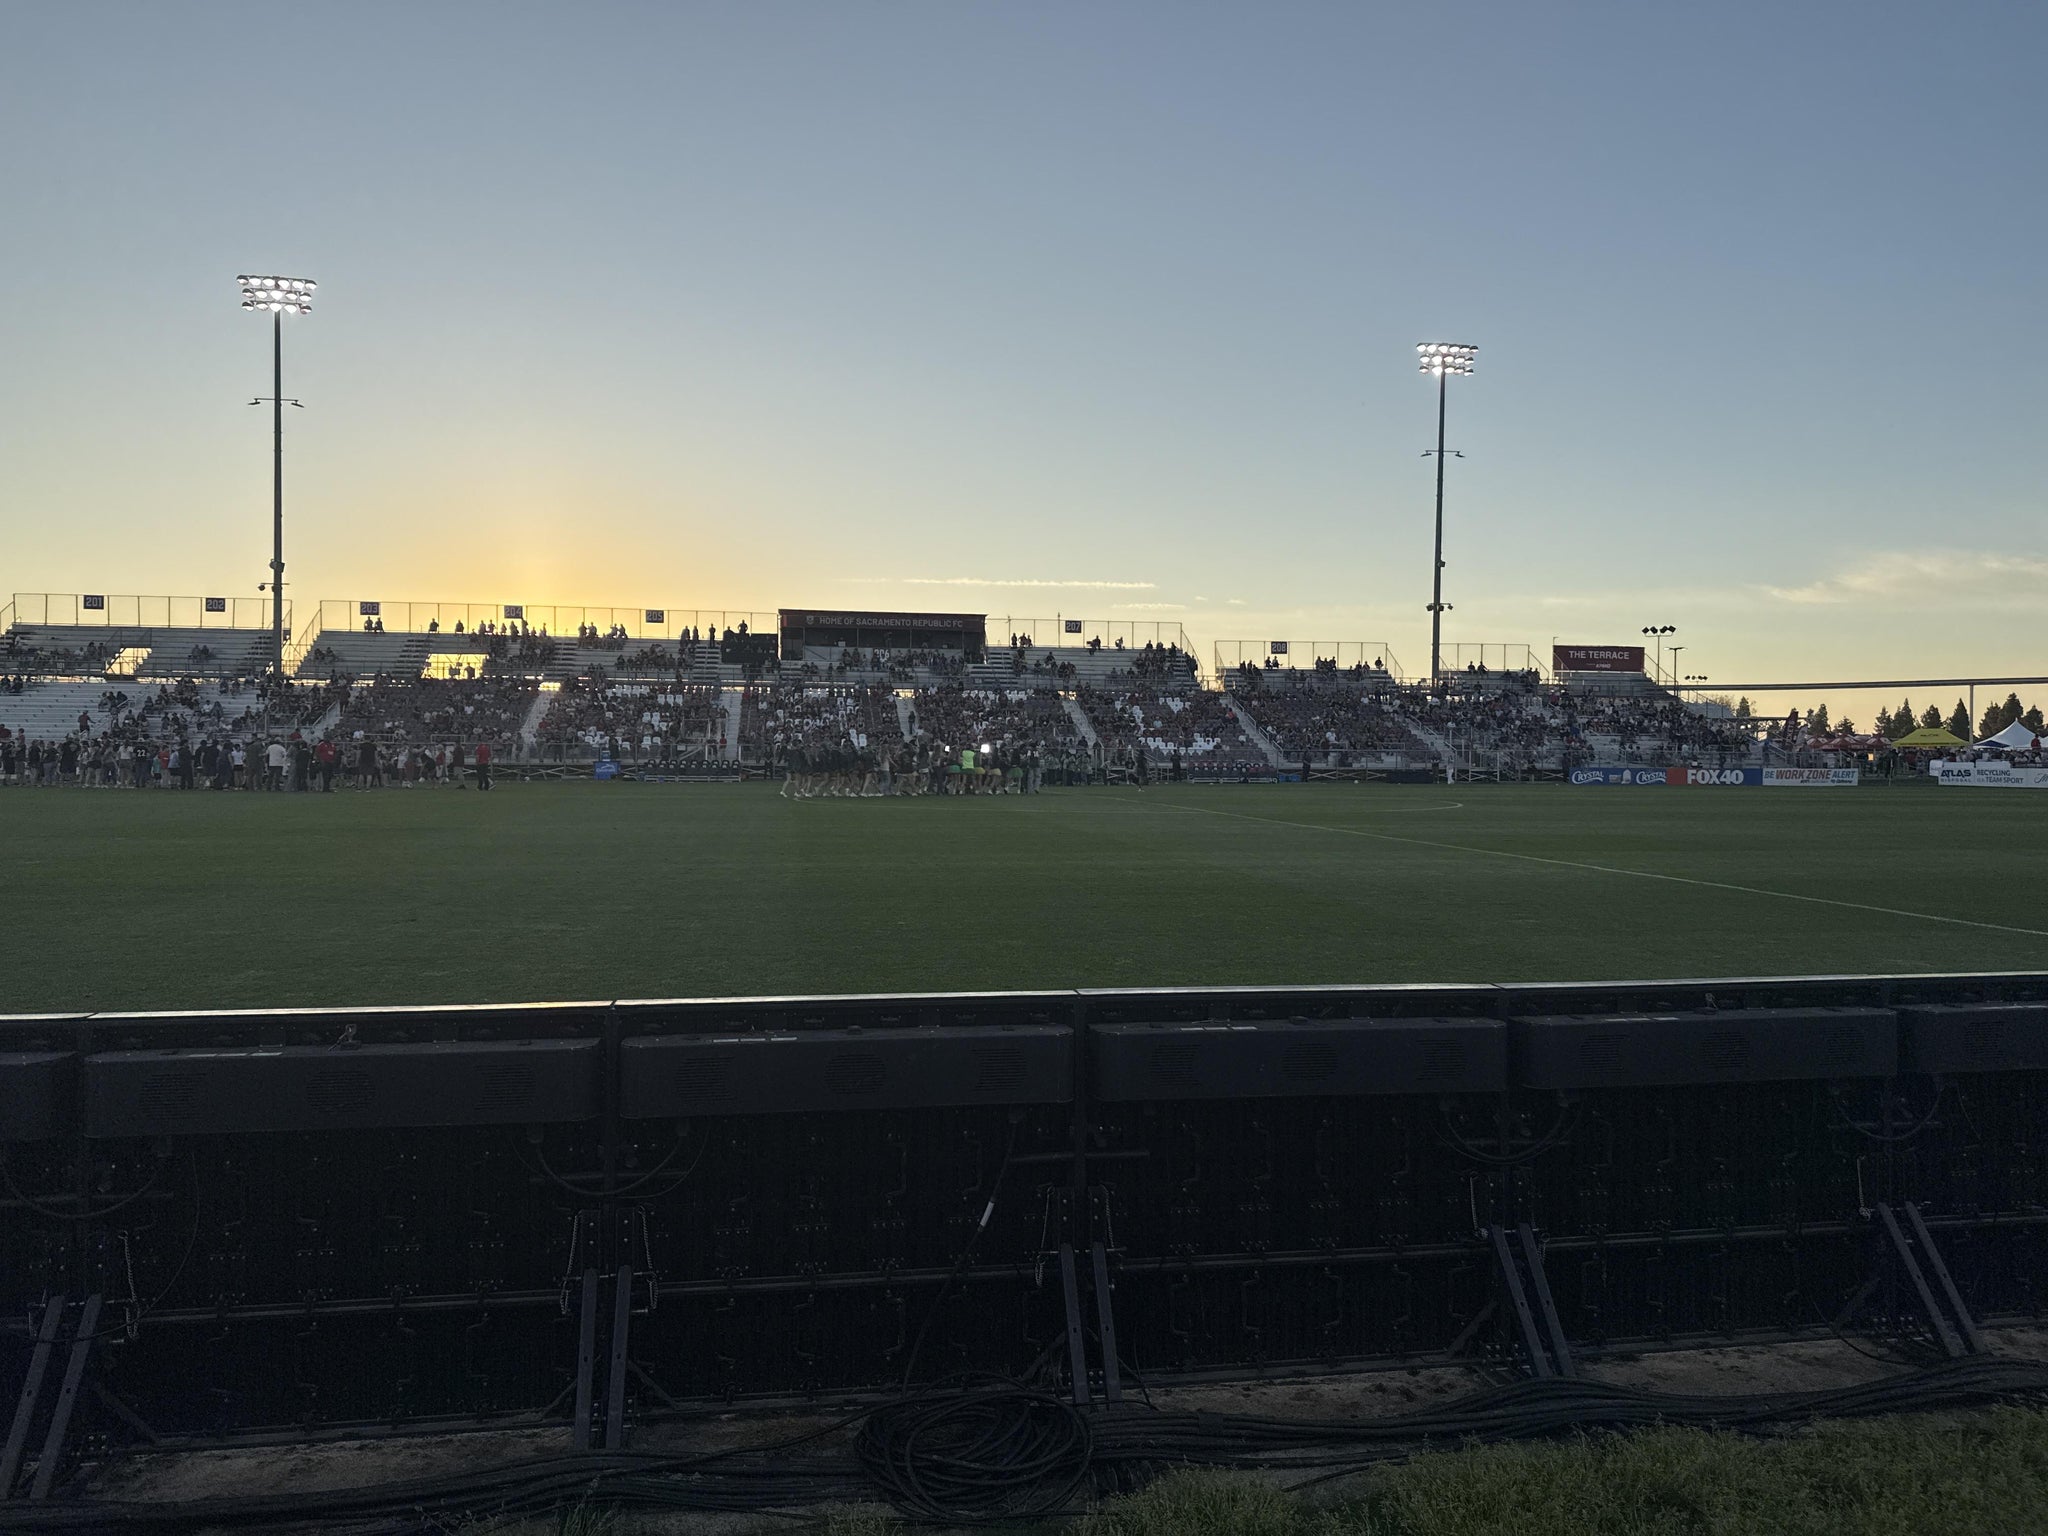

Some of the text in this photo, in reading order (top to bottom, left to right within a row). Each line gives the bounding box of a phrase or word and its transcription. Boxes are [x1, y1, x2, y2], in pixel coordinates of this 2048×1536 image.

[86, 597, 102, 607] 201
[207, 599, 224, 610] 202
[361, 603, 378, 613] 203
[505, 607, 521, 617] 204
[647, 611, 663, 621] 205
[819, 616, 963, 628] HOME OF SACRAMENTO REPUBLIC FC
[1066, 622, 1080, 631] 207
[1272, 643, 1286, 653] 208
[1568, 650, 1630, 660] THE TERRACE
[136, 749, 146, 758] 22
[1571, 770, 1604, 785] CRYSTAL
[1635, 771, 1667, 785] CRYSTAL
[1687, 769, 1744, 785] FOX40
[1764, 769, 1855, 779] BE WORK ZONE ALERT
[1940, 769, 1971, 778] ATLAS
[1976, 769, 2010, 777] RECYCLING
